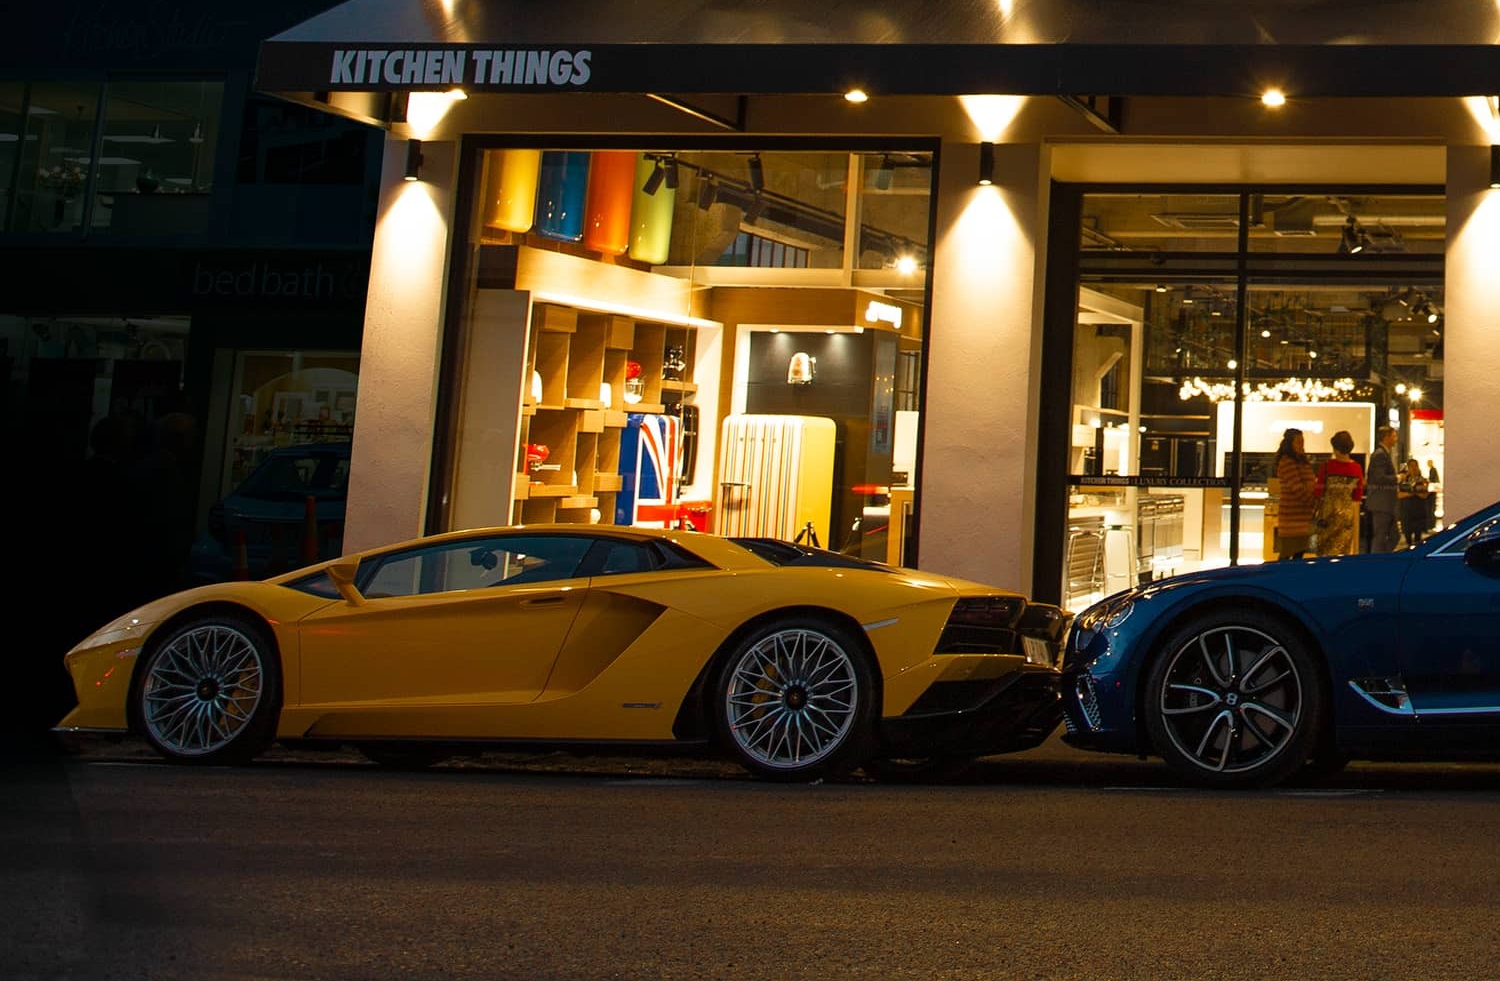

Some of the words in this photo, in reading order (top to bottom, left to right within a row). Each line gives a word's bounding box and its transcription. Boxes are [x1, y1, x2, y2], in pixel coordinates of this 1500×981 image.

[330, 50, 466, 84] KITCHEN
[472, 50, 592, 85] THINGS
[192, 260, 257, 296] bed
[261, 260, 335, 299] bath
